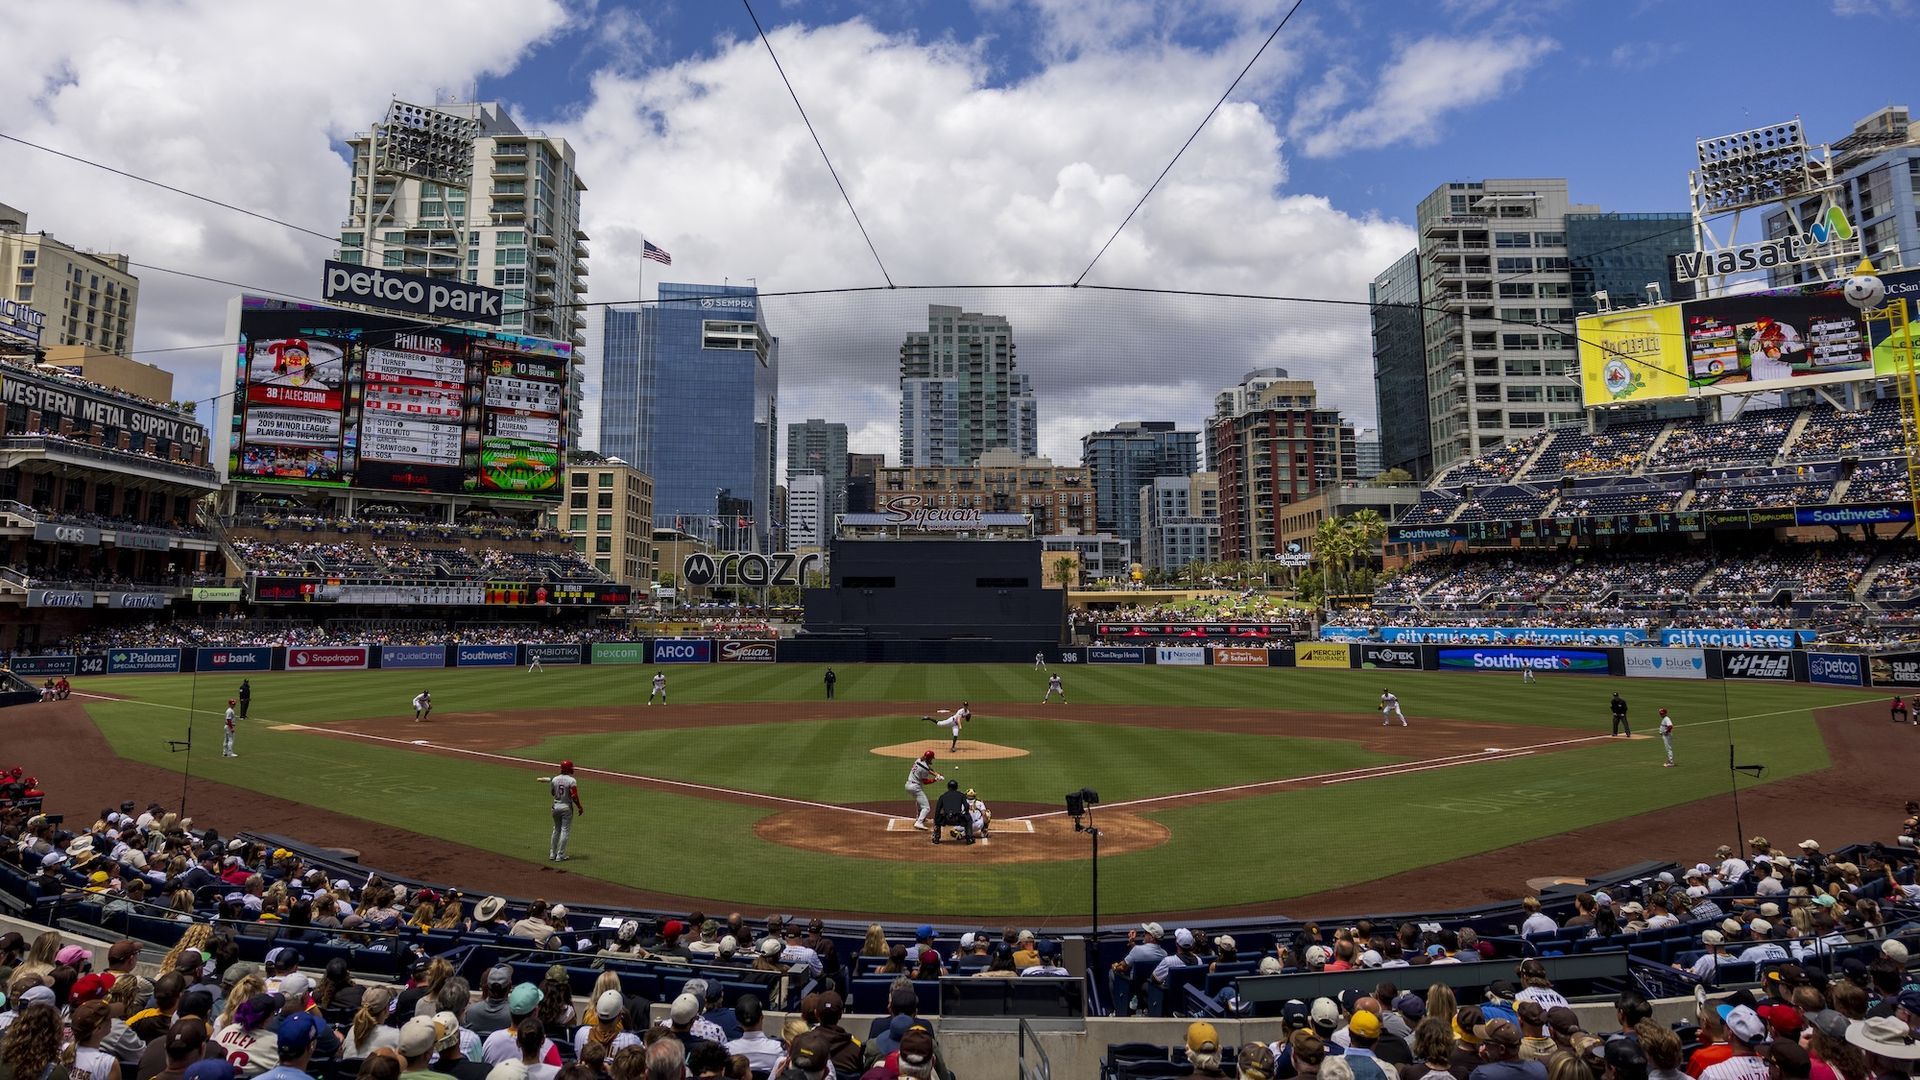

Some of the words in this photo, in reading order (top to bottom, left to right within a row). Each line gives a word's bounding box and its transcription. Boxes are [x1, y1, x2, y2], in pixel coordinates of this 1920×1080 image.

[1677, 236, 1800, 279] Viasat
[326, 267, 424, 304] petco
[428, 284, 500, 316] park
[1884, 284, 1899, 295] UC
[1900, 282, 1919, 293] San
[715, 299, 754, 308] SEMPRA
[394, 332, 442, 354] PHILLIES
[381, 350, 420, 361] SCHWARBER
[381, 358, 406, 367] TURNER
[516, 362, 526, 374] 10
[381, 366, 406, 375] HARPER
[528, 369, 555, 378] BUEHLER
[381, 374, 399, 383] BOHM
[434, 380, 443, 388] 3B
[266, 387, 278, 398] 3B
[285, 388, 303, 402] ALEC
[303, 391, 326, 404] BOHM
[3, 378, 77, 417] WESTERN
[82, 399, 128, 430] METAL
[131, 413, 179, 440] SUPPLY
[182, 425, 201, 446] CO.
[257, 410, 274, 420] WAS
[258, 420, 275, 428] 2019
[276, 421, 300, 430] MINOR
[301, 423, 329, 432] LEAGUE
[377, 419, 397, 427] STOTT
[498, 422, 528, 431] LAUREANO
[256, 428, 283, 438] PLAYER
[285, 429, 295, 438] OF
[296, 430, 310, 439] THE
[311, 431, 330, 440] YEAR
[377, 428, 410, 436] REALMUTO
[498, 430, 522, 438] MERRILL
[376, 444, 410, 452] CRAWFORD
[885, 494, 984, 531] Sycuan
[1813, 507, 1890, 522] Southwest
[56, 526, 85, 542] ORIS
[1399, 528, 1450, 539] Southwest
[1275, 553, 1312, 561] Gallagher
[719, 552, 820, 586] razr
[1280, 560, 1306, 568] Square
[504, 590, 510, 604] 0
[1668, 630, 1793, 648] citycruises
[396, 651, 442, 661] QuidelOrtho
[461, 652, 507, 660] Southwest
[528, 648, 579, 656] CYMBIOTIKA
[656, 646, 695, 658] ARCO
[722, 642, 770, 660] Sycuan
[130, 652, 177, 663] Palomar
[212, 654, 226, 664] us
[228, 652, 256, 664] bank
[312, 654, 360, 664] Snapdragon
[1062, 652, 1078, 663] 396
[1474, 653, 1559, 670] Southwest
[1627, 656, 1651, 666] blue
[1666, 657, 1692, 666] blue
[1750, 655, 1790, 669] H2O
[82, 659, 103, 672] 342
[1825, 658, 1857, 676] petco
[1892, 662, 1918, 672] SLAP
[1747, 669, 1788, 678] POWER
[223, 1031, 256, 1049] UTLEY
